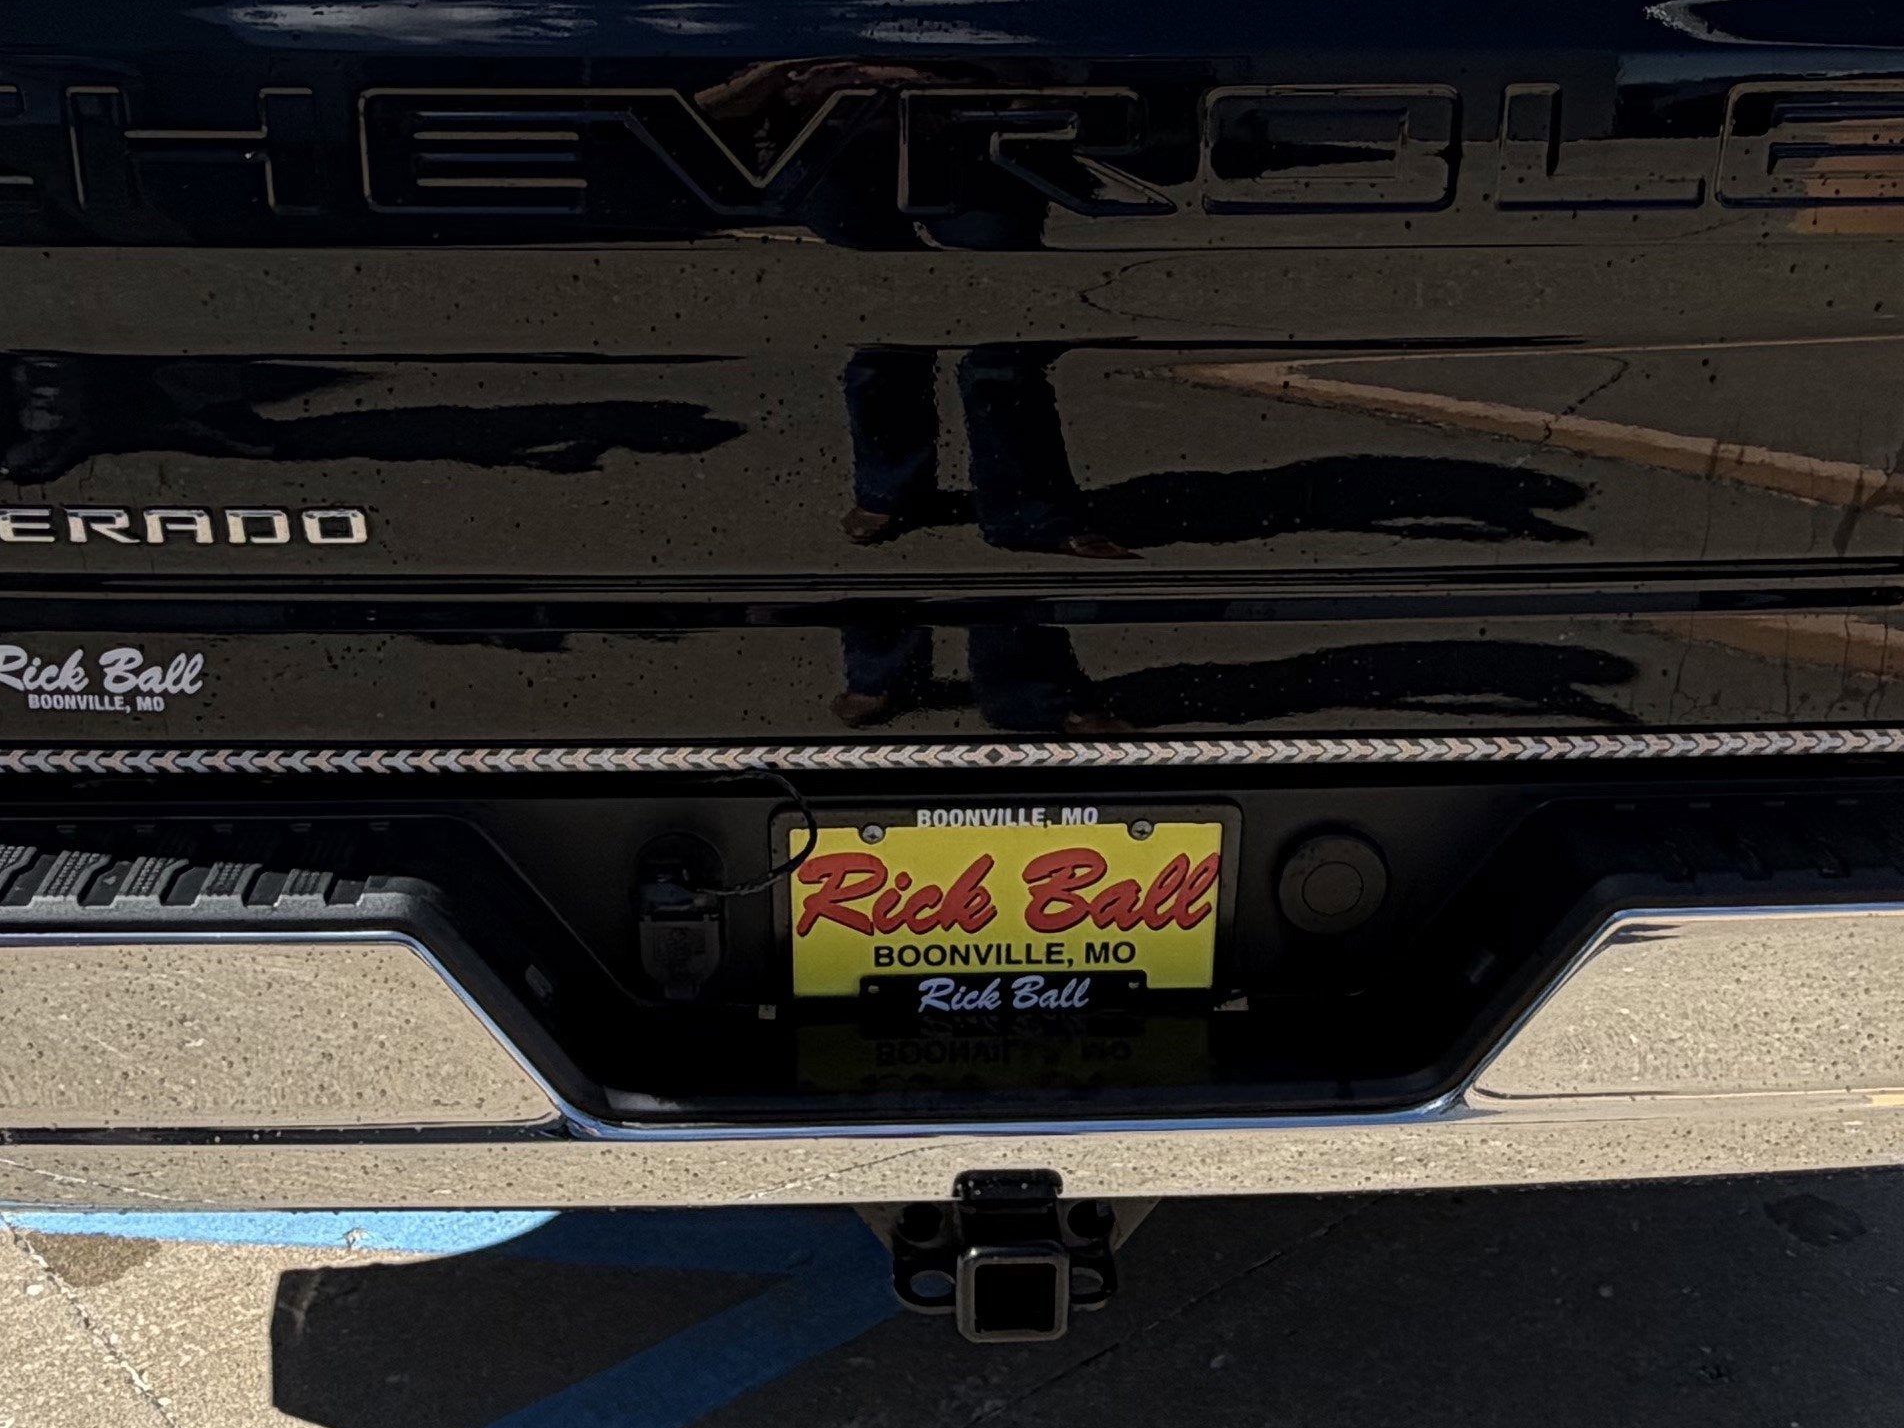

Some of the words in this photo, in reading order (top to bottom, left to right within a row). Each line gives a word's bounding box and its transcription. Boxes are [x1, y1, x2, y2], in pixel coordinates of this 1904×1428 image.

[98, 647, 205, 695] Ball
[27, 694, 132, 714] BOONVILLE,
[136, 696, 166, 712] MO
[916, 807, 1052, 828] BOONVILLE,
[1061, 806, 1099, 826] MO
[798, 852, 998, 937] Rick
[1022, 848, 1220, 933] Ball
[873, 943, 1074, 968] BOONVILLE,
[1084, 941, 1137, 964] MO
[917, 977, 1002, 1013] Rick
[1011, 974, 1091, 1010] Ball
